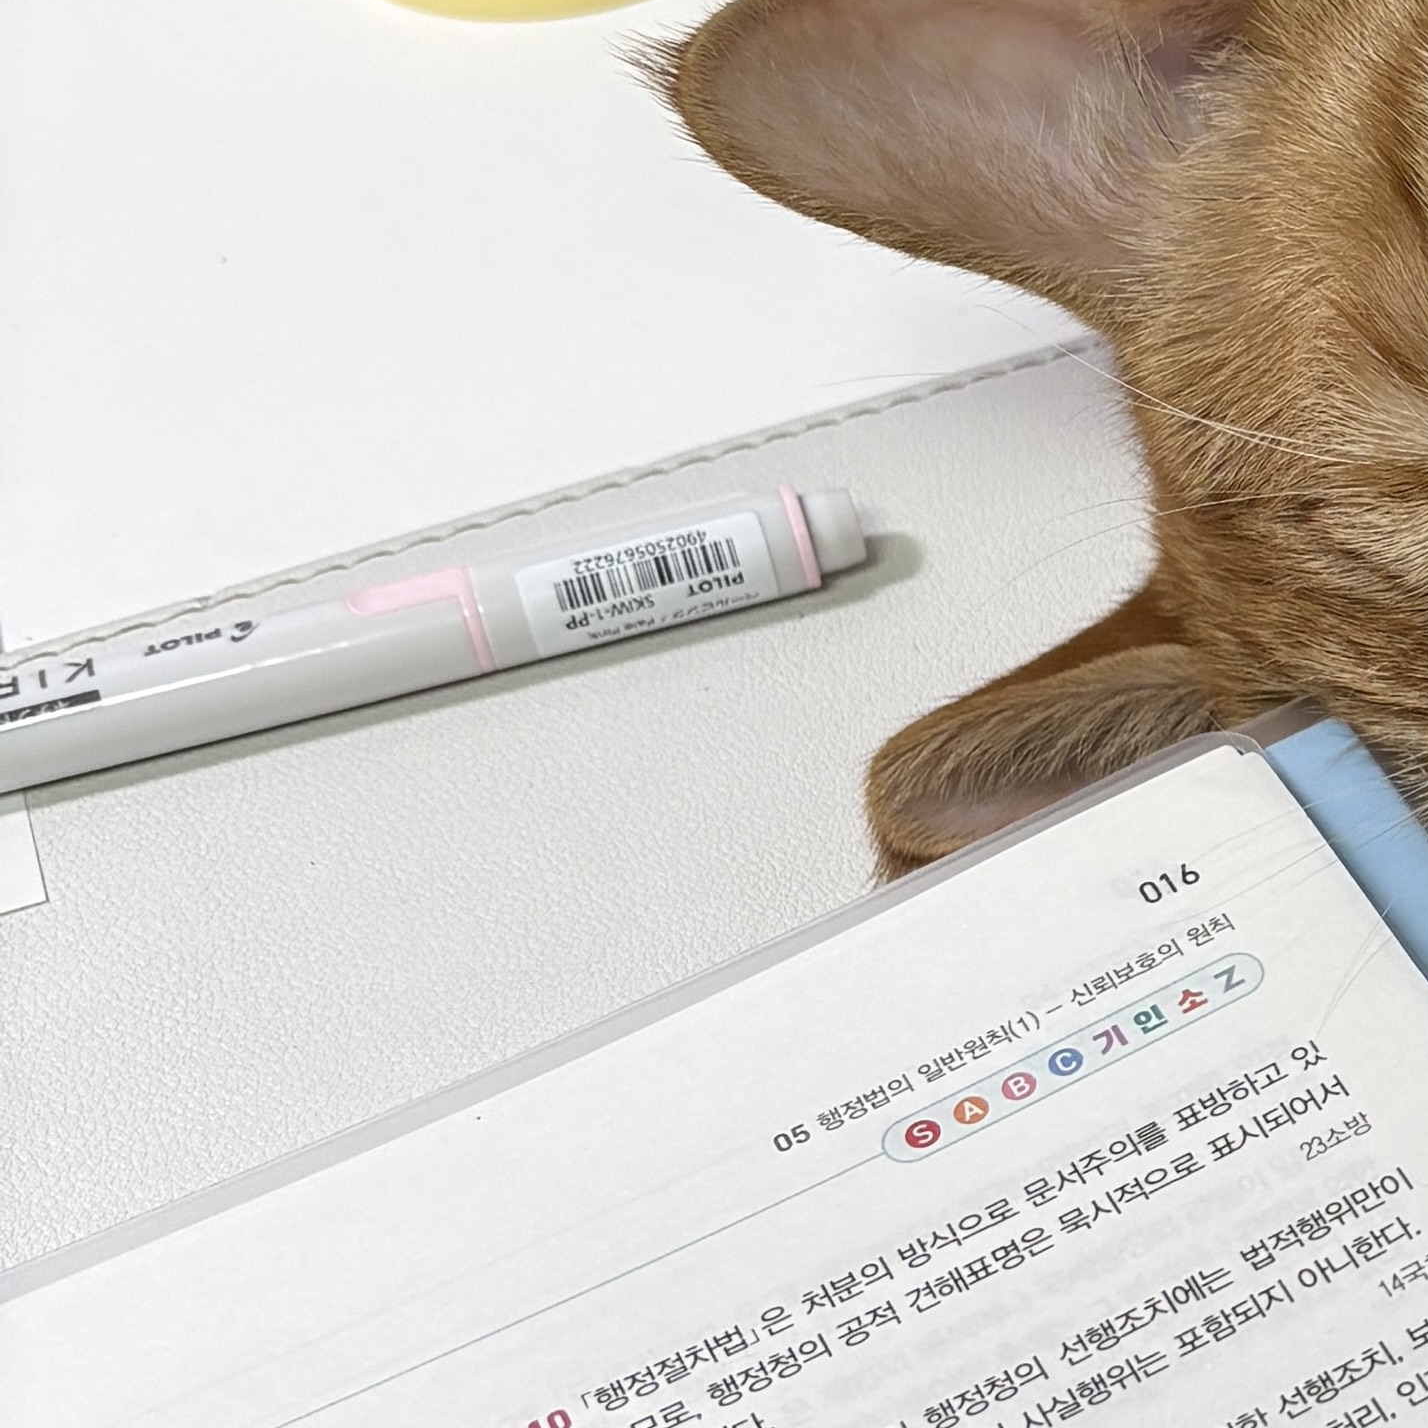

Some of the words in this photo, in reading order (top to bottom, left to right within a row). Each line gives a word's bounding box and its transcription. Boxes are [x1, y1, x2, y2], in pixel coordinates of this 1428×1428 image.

[572, 528, 706, 575] 4902505676222
[685, 570, 744, 598] PILOT
[142, 628, 221, 656] PILOT
[563, 591, 654, 630] SKIW-1-PP
[1138, 862, 1202, 905] 016
[773, 1123, 811, 1152] 05
[815, 1073, 916, 1131] 행정법의
[917, 1010, 1041, 1083] 일반원칙(1)
[1070, 938, 1185, 1007] 신뢰보호의
[1186, 912, 1236, 948] 원칙
[908, 1120, 936, 1148] S
[957, 1096, 985, 1124] A
[1005, 1072, 1033, 1100] B
[1052, 1047, 1080, 1075] C
[1092, 1024, 1129, 1056] 기
[1132, 1003, 1169, 1035] 인
[1177, 988, 1209, 1015] 소
[1213, 964, 1246, 994] Z
[1299, 1111, 1372, 1162] 23소방
[580, 1306, 795, 1412] 「행정절차법」은
[801, 1256, 895, 1315] 처분의
[896, 1198, 1021, 1269] 방식으로
[1023, 1120, 1169, 1208] 문서주의를
[1172, 1061, 1289, 1132] 표방하고
[1290, 1039, 1328, 1072] 있
[706, 1332, 833, 1407] 행정청의
[836, 1299, 902, 1347] 공적
[904, 1227, 1055, 1314] 견해표명은
[1058, 1151, 1206, 1234] 묵시적으로
[1206, 1073, 1350, 1162] 표시되어서
[1059, 1267, 1235, 1367] 선행조치에는
[1239, 1166, 1414, 1272] 법적행위만이
[1173, 1278, 1295, 1358] 포함되지
[1297, 1216, 1422, 1288] 아니한다.
[1278, 1340, 1404, 1420] 선행조치,
